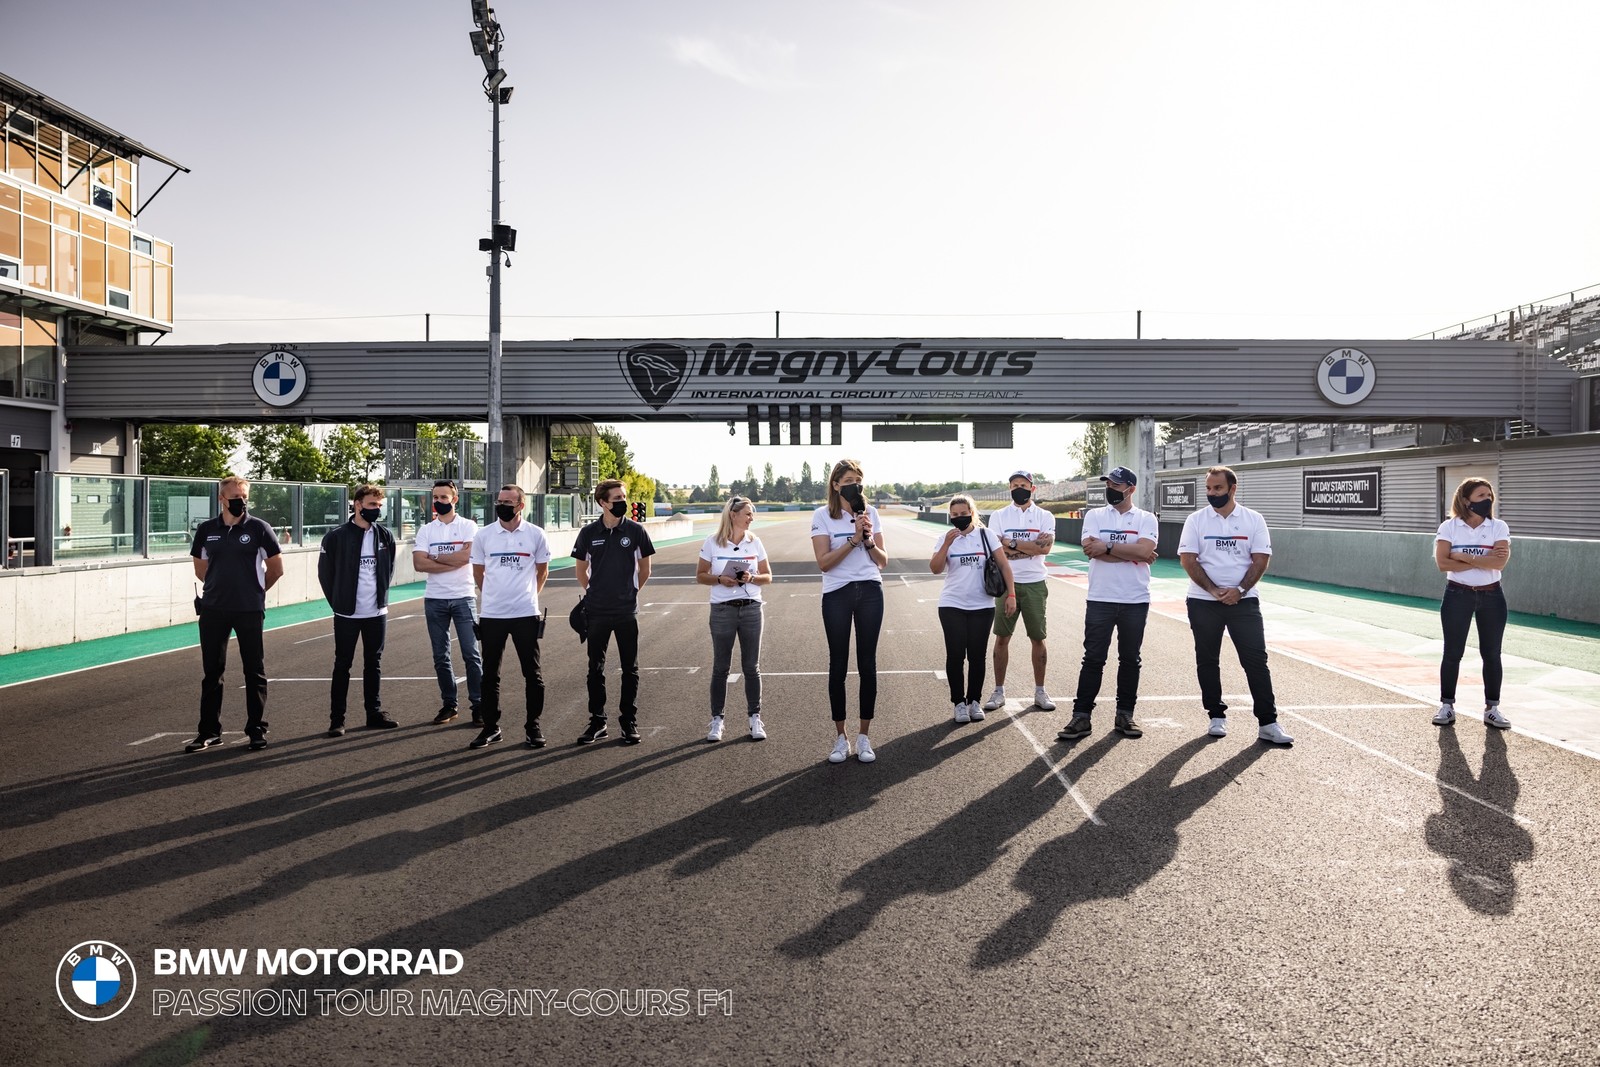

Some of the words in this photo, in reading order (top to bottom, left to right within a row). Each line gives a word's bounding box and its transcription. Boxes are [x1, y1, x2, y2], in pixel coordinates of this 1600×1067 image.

[260, 353, 300, 368] BMW
[698, 342, 1037, 383] Magny-Cours
[1325, 350, 1369, 366] BMW
[691, 390, 825, 398] INTERNATIONAL
[831, 390, 898, 398] CIRCUIT
[910, 390, 964, 398] NEVERS
[968, 390, 1024, 398] FRANCE
[11, 436, 20, 447] 47
[1311, 482, 1319, 491] MY
[1320, 481, 1331, 491] DAY
[1331, 481, 1353, 491] STARTS
[1353, 480, 1369, 491] WITH
[1311, 493, 1333, 503] LAUNCH
